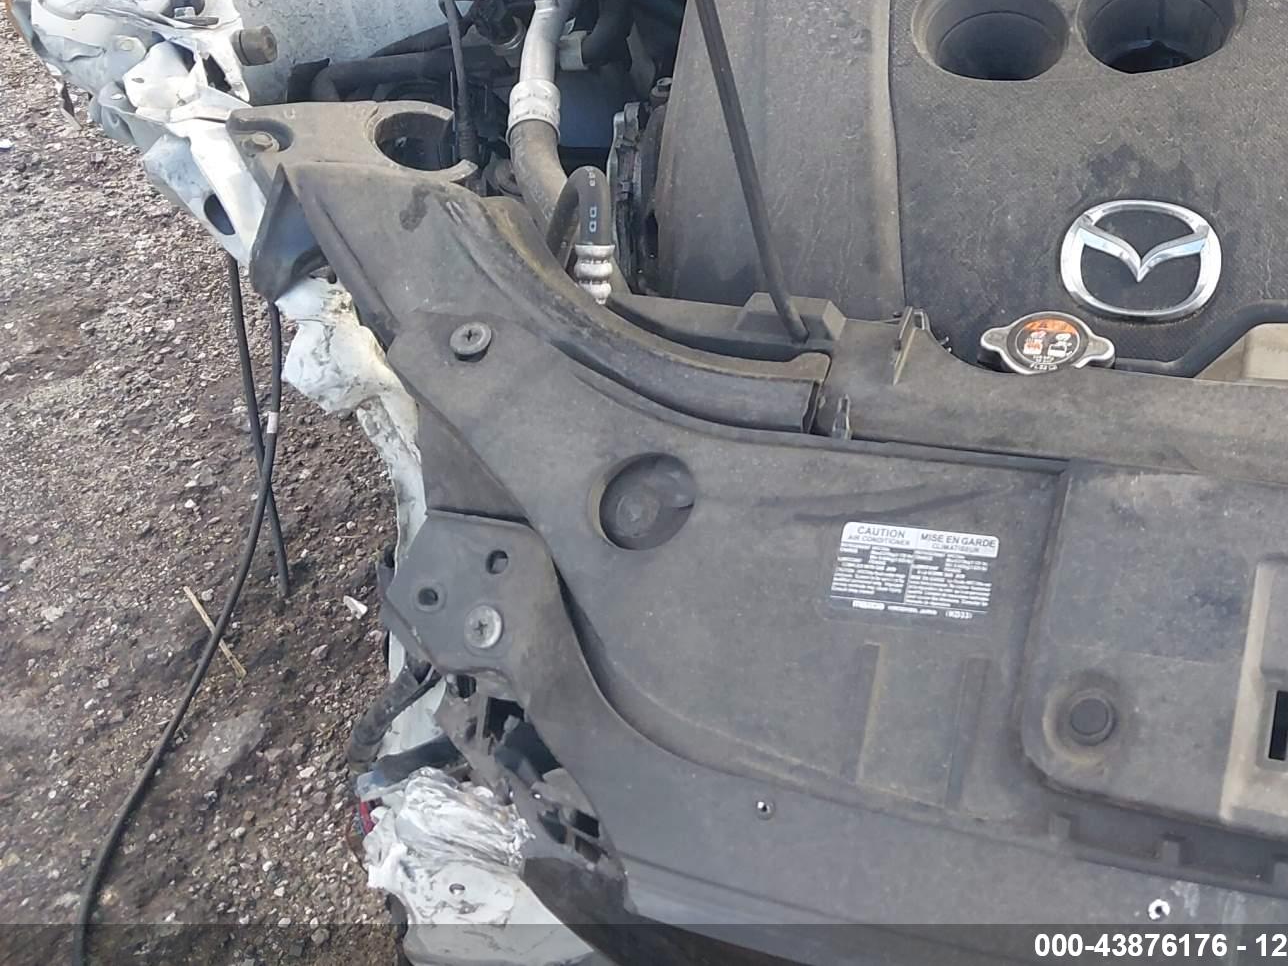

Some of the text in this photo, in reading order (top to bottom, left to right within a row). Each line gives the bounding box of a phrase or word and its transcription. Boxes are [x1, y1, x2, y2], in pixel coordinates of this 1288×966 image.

[857, 525, 906, 539] CAUTION
[920, 533, 996, 548] MISE EN GARDE
